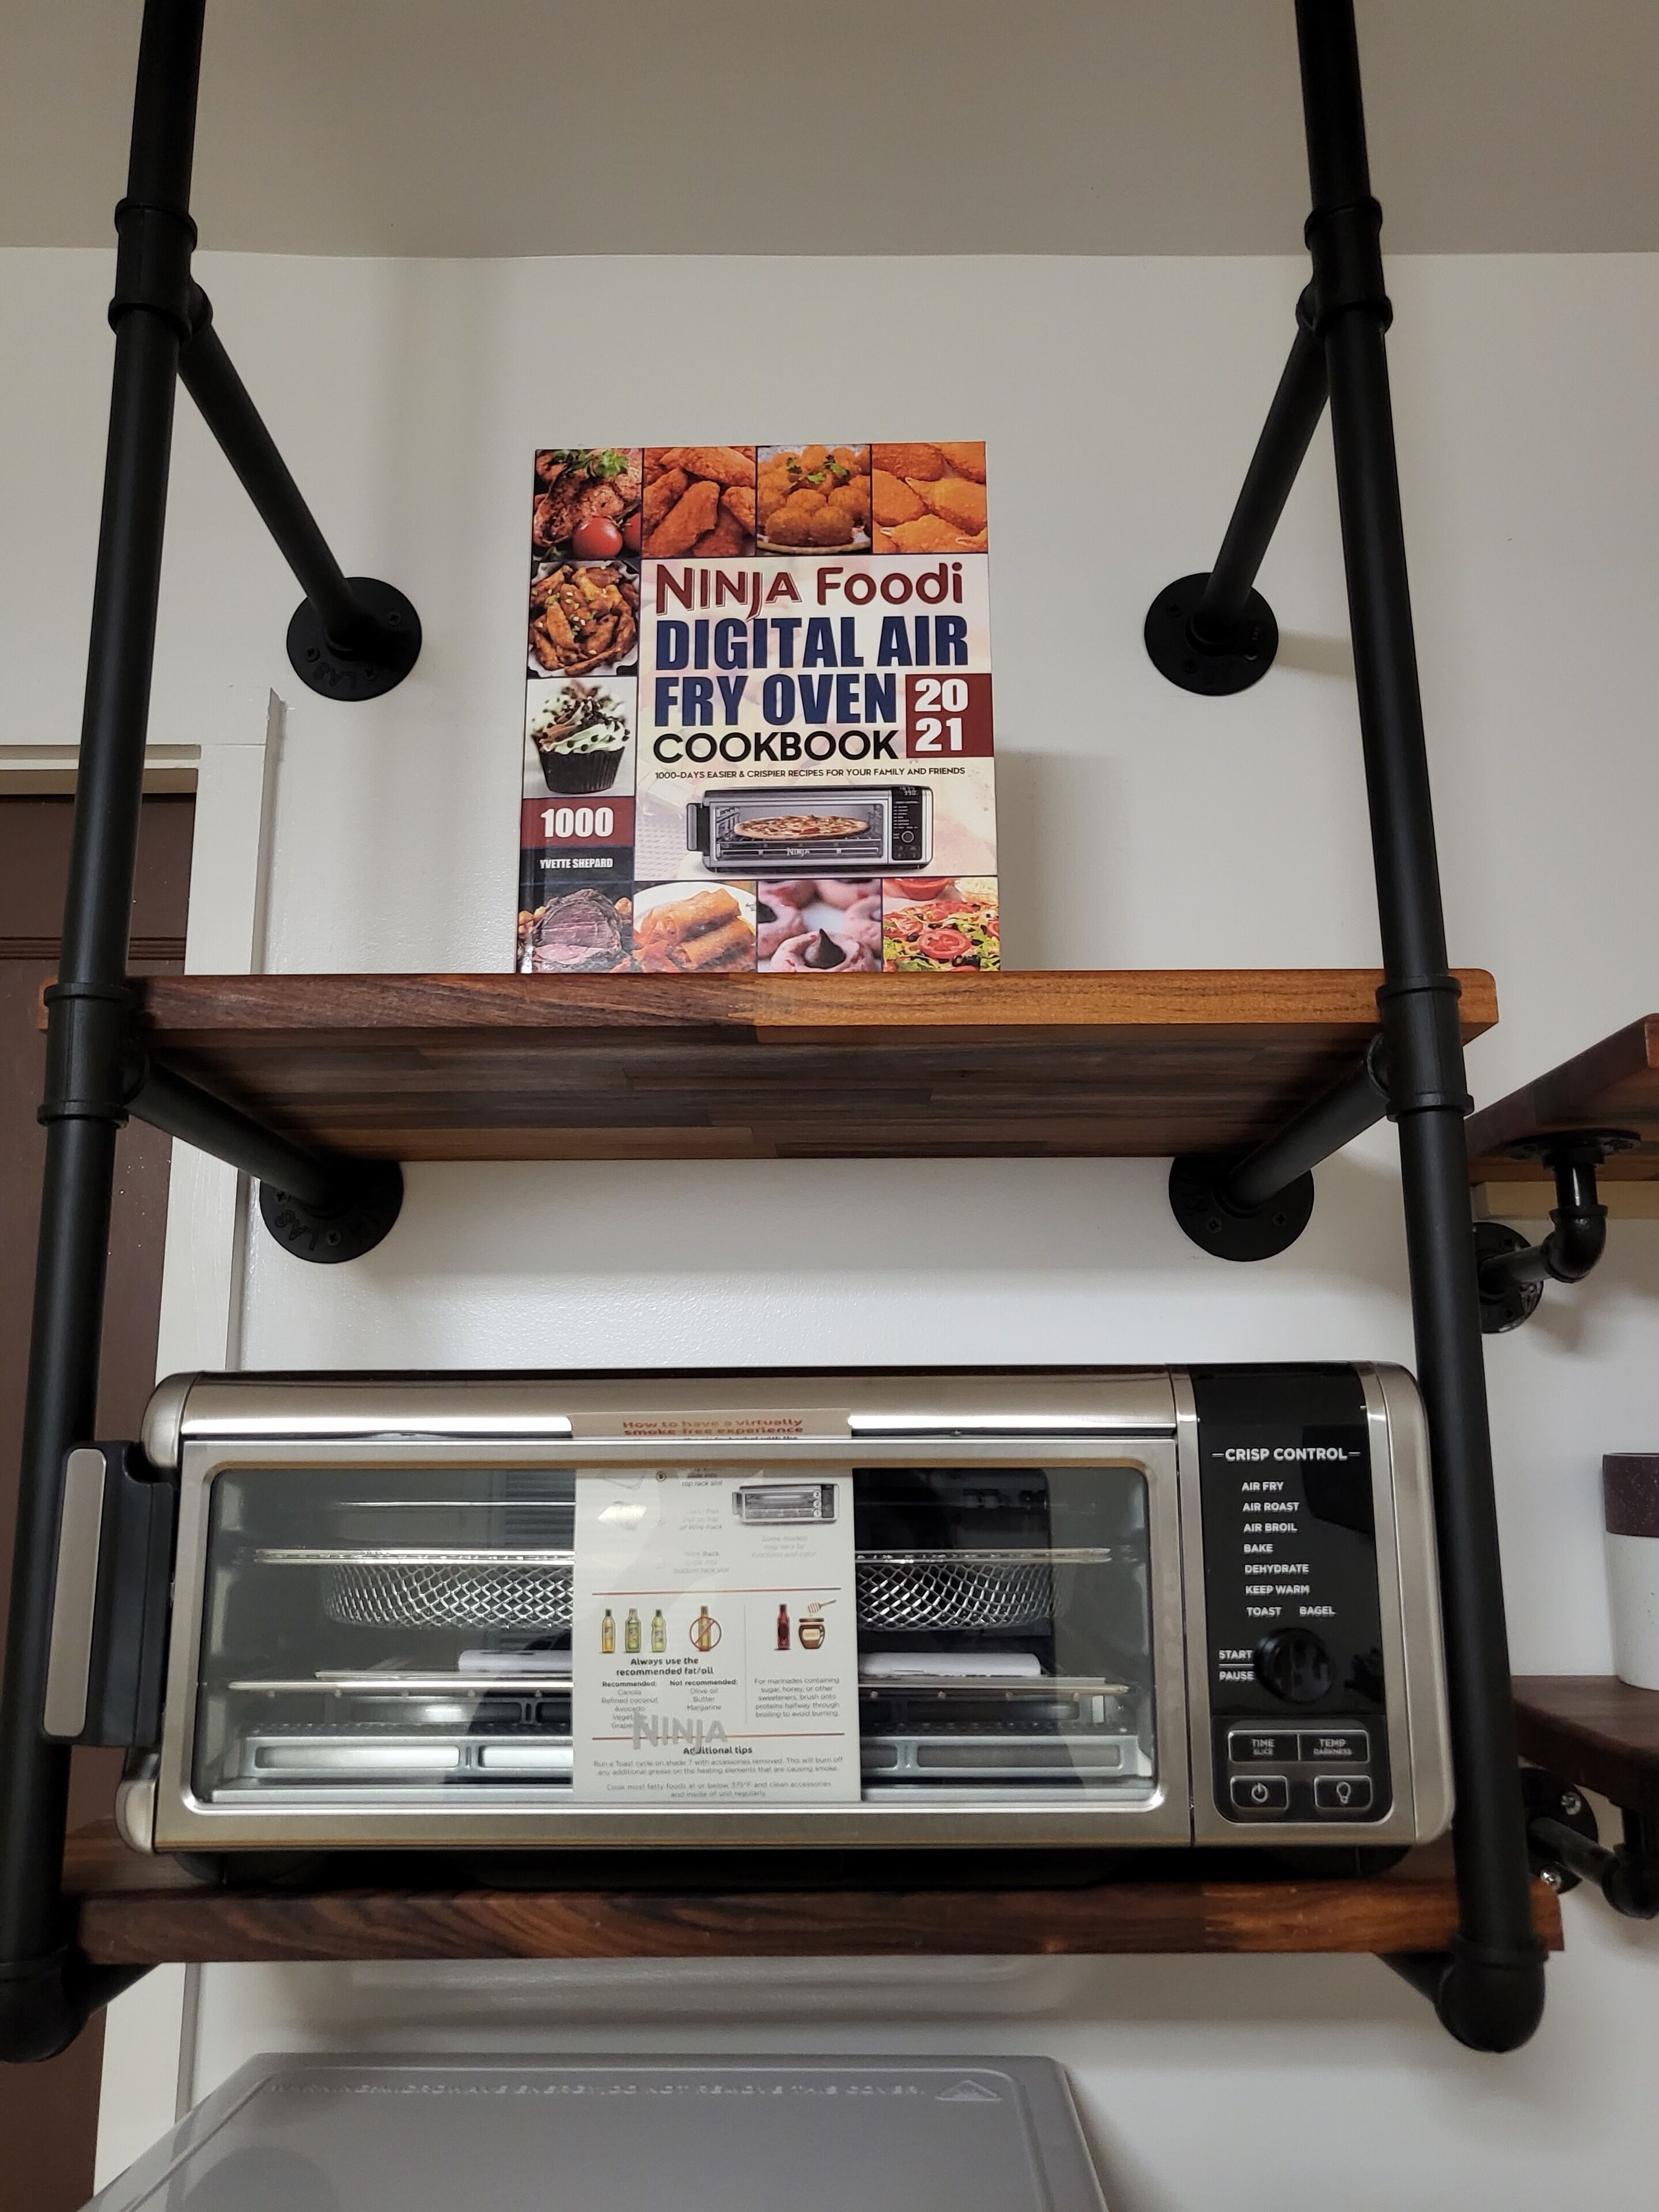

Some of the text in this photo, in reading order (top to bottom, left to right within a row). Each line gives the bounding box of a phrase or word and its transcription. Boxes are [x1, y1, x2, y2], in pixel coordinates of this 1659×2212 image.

[816, 562, 963, 605] Foodi
[656, 614, 969, 671] DIGITAL AIR
[654, 672, 897, 727] FRY OVEN
[914, 678, 969, 713] 20
[914, 716, 965, 752] 21
[653, 729, 899, 764] COOKBOOK
[788, 769, 824, 777] RECIPES
[540, 806, 614, 838] 1000
[539, 857, 613, 869] YVETTE SHEPARD
[736, 1418, 803, 1427] virtually
[717, 1426, 804, 1435] experience
[1225, 1447, 1348, 1461] CRISP CONTROL
[1241, 1481, 1285, 1492] AIR FRY
[1243, 1502, 1300, 1513] AIR ROAST
[1243, 1522, 1298, 1533] AIR BROIL
[1243, 1543, 1274, 1554] BAKE
[1244, 1563, 1310, 1574] DEHYDRATE
[1245, 1584, 1310, 1595] KEEP WARM
[1246, 1605, 1336, 1617] TOAST BAGEL
[1219, 1649, 1253, 1660] START
[630, 1657, 663, 1666] Always
[616, 1665, 714, 1676] recommended fat/oil
[1219, 1671, 1255, 1681] PAUSE
[684, 1678, 738, 1687] recommended:
[687, 1703, 722, 1711] Margarine
[812, 1701, 840, 1709] through
[633, 1709, 728, 1753] NINJA
[1251, 1738, 1347, 1748] TIME TEMP
[734, 1745, 753, 1755] tips
[696, 1766, 723, 1775] heating
[790, 1779, 832, 1787] accessories
